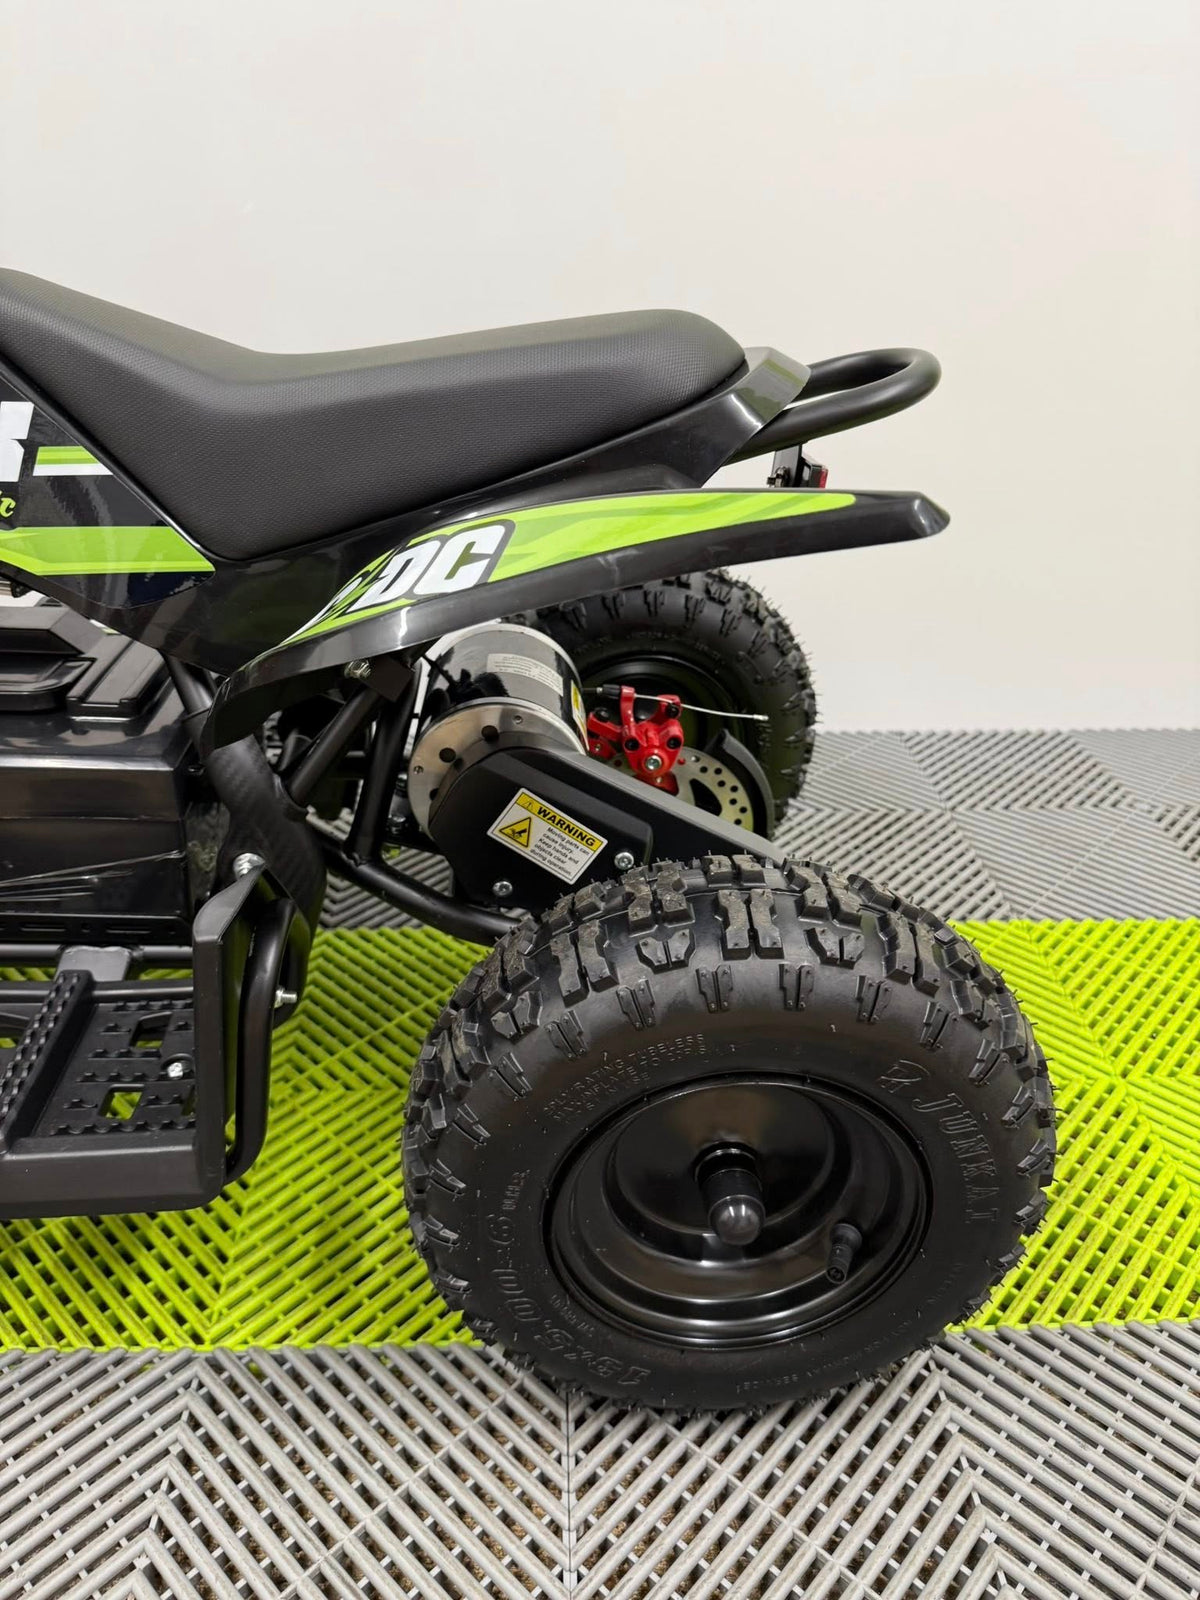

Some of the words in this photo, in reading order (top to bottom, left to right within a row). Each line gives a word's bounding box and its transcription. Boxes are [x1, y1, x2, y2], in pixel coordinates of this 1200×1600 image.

[536, 806, 596, 847] WARNING
[543, 833, 558, 844] cause
[547, 827, 566, 841] Moving
[566, 839, 579, 850] parts
[580, 847, 589, 855] can
[530, 848, 547, 861] during
[534, 843, 553, 857] objects
[553, 854, 566, 864] clear
[539, 838, 552, 848] Keep
[553, 846, 568, 857] hands
[568, 856, 578, 864] and
